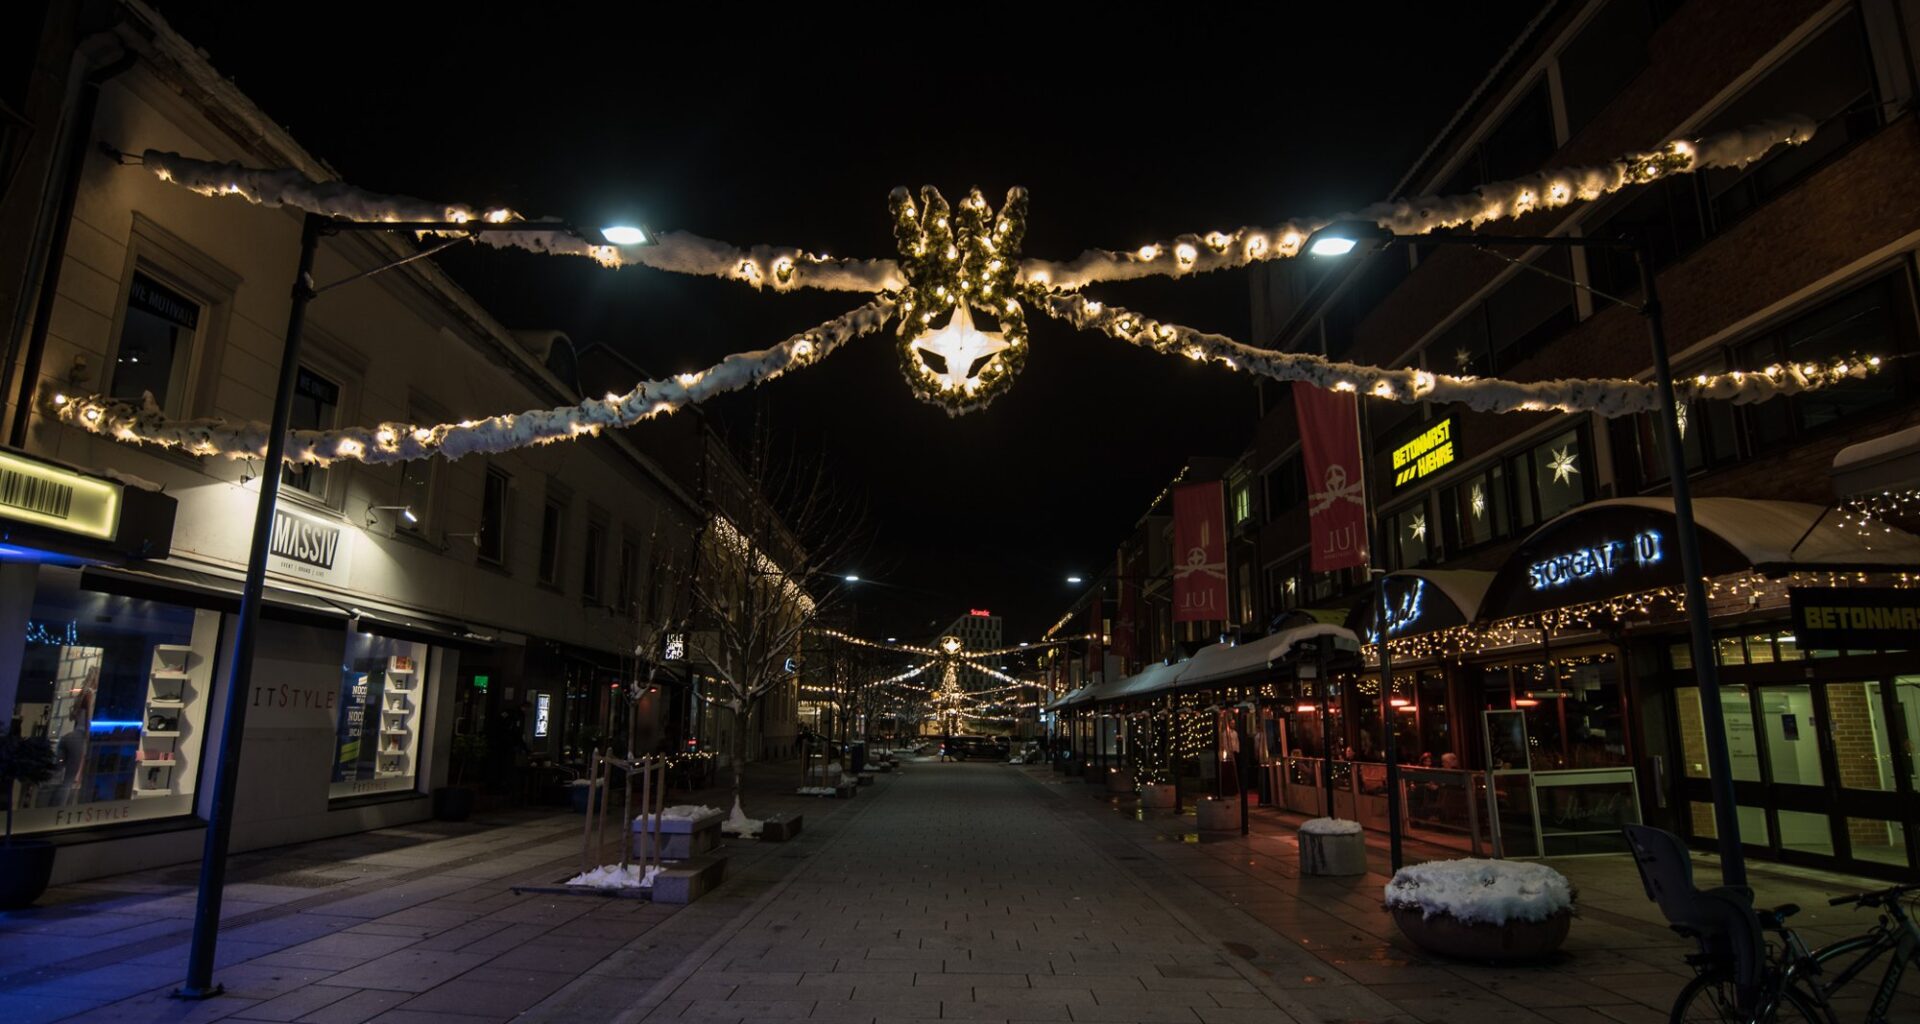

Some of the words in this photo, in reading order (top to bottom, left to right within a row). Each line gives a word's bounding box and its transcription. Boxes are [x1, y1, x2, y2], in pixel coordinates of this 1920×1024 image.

[272, 512, 338, 567] MASSIV
[1803, 605, 1920, 630] BETONMA
[253, 683, 336, 709] ITSTYLE
